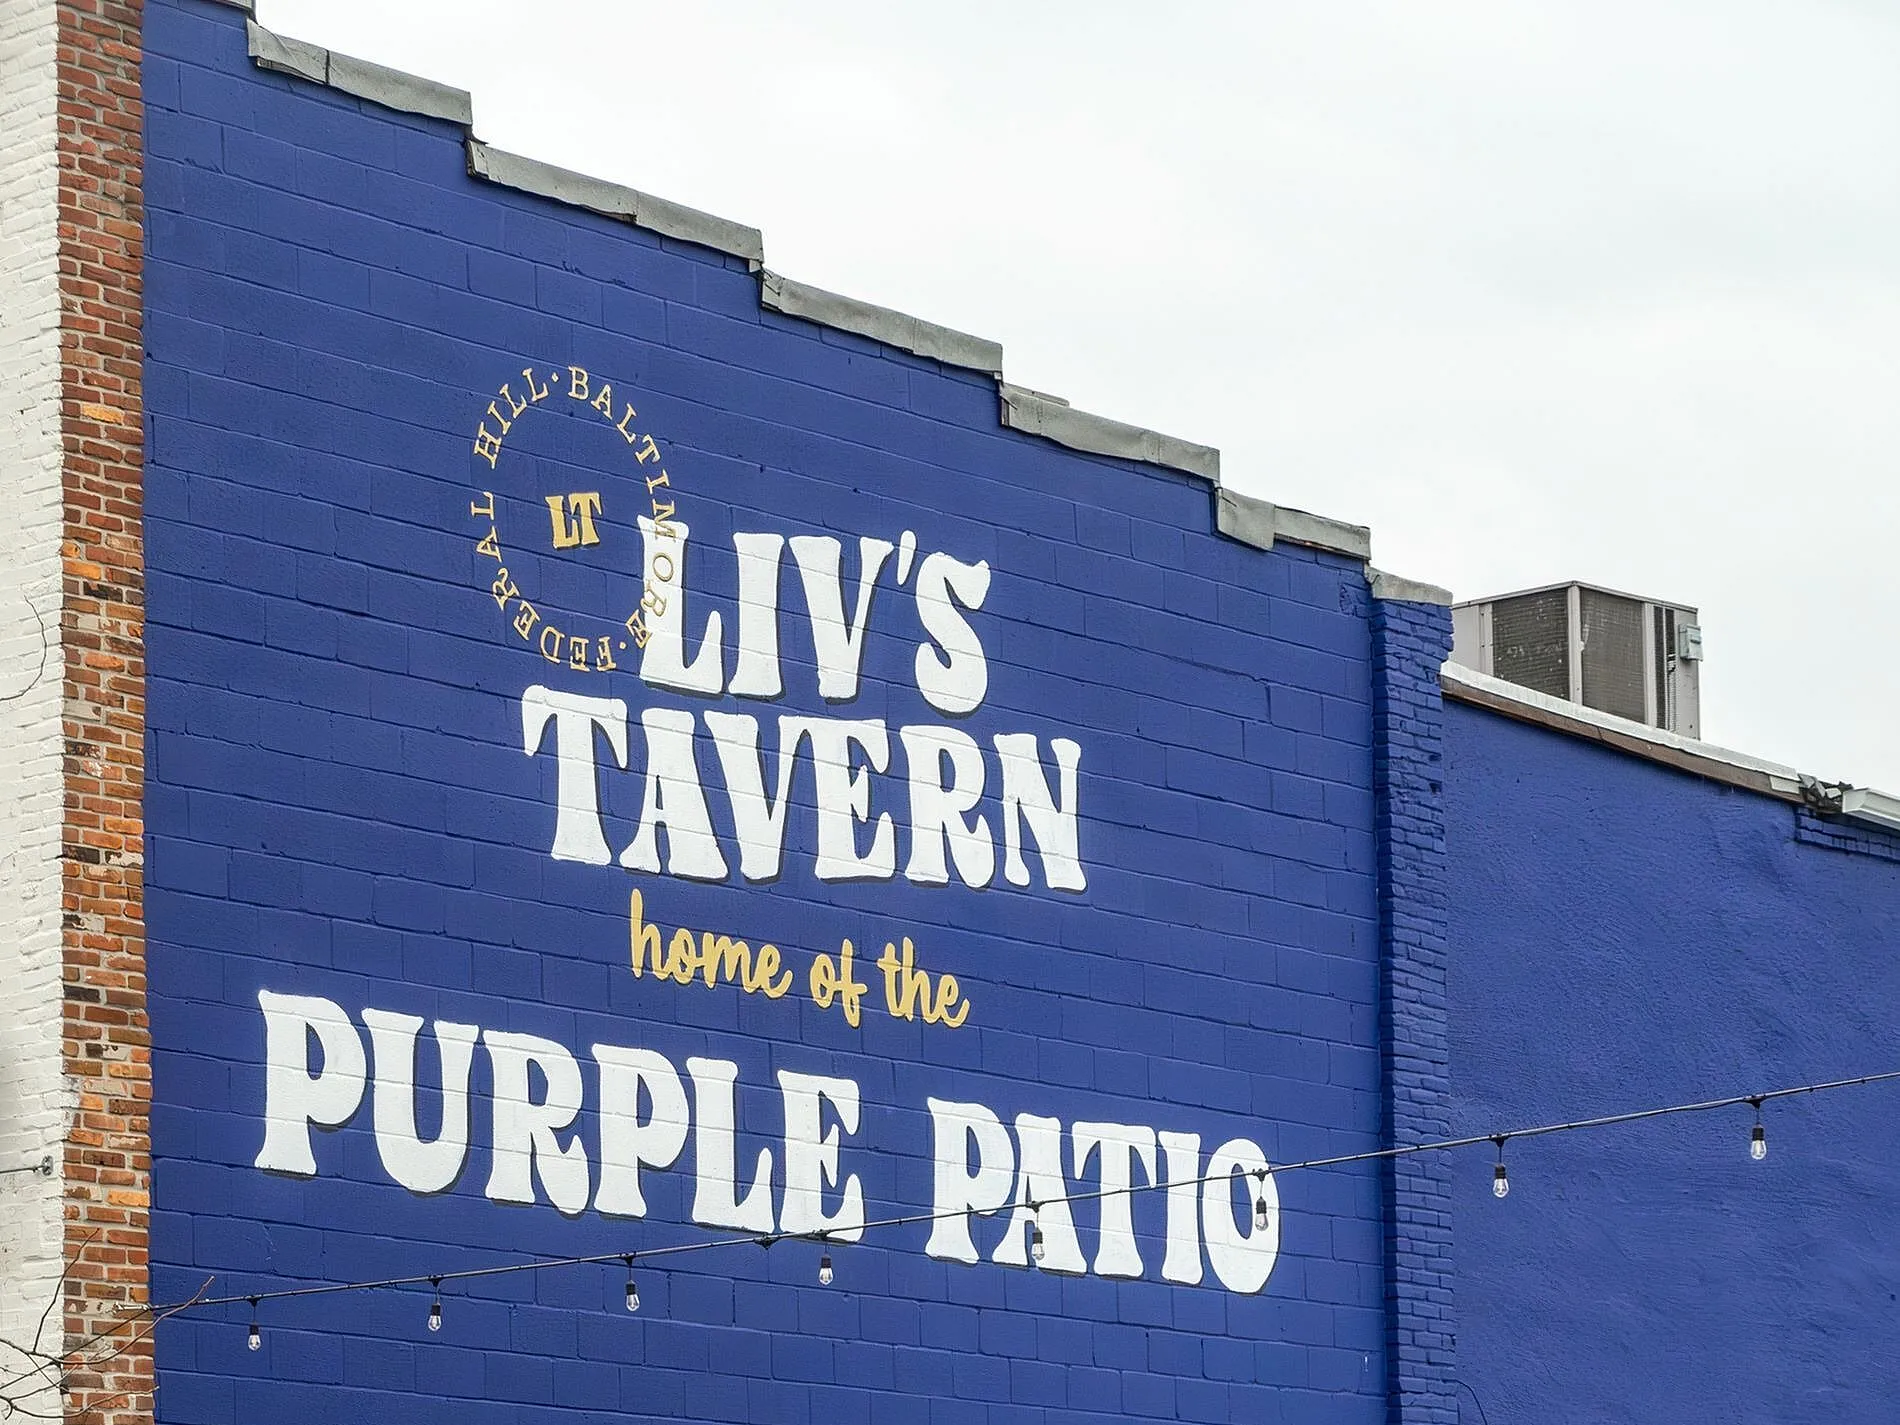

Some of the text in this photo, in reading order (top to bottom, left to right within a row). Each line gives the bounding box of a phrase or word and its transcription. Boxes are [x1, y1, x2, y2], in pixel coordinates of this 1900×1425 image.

[471, 365, 678, 672] FEDERAL HILL BALTIMORE
[545, 492, 602, 549] LT
[636, 514, 992, 714] LIV'S
[520, 684, 1088, 891] TAVERN
[630, 888, 970, 1028] home of the
[254, 989, 1281, 1295] PURPLE PATIO
